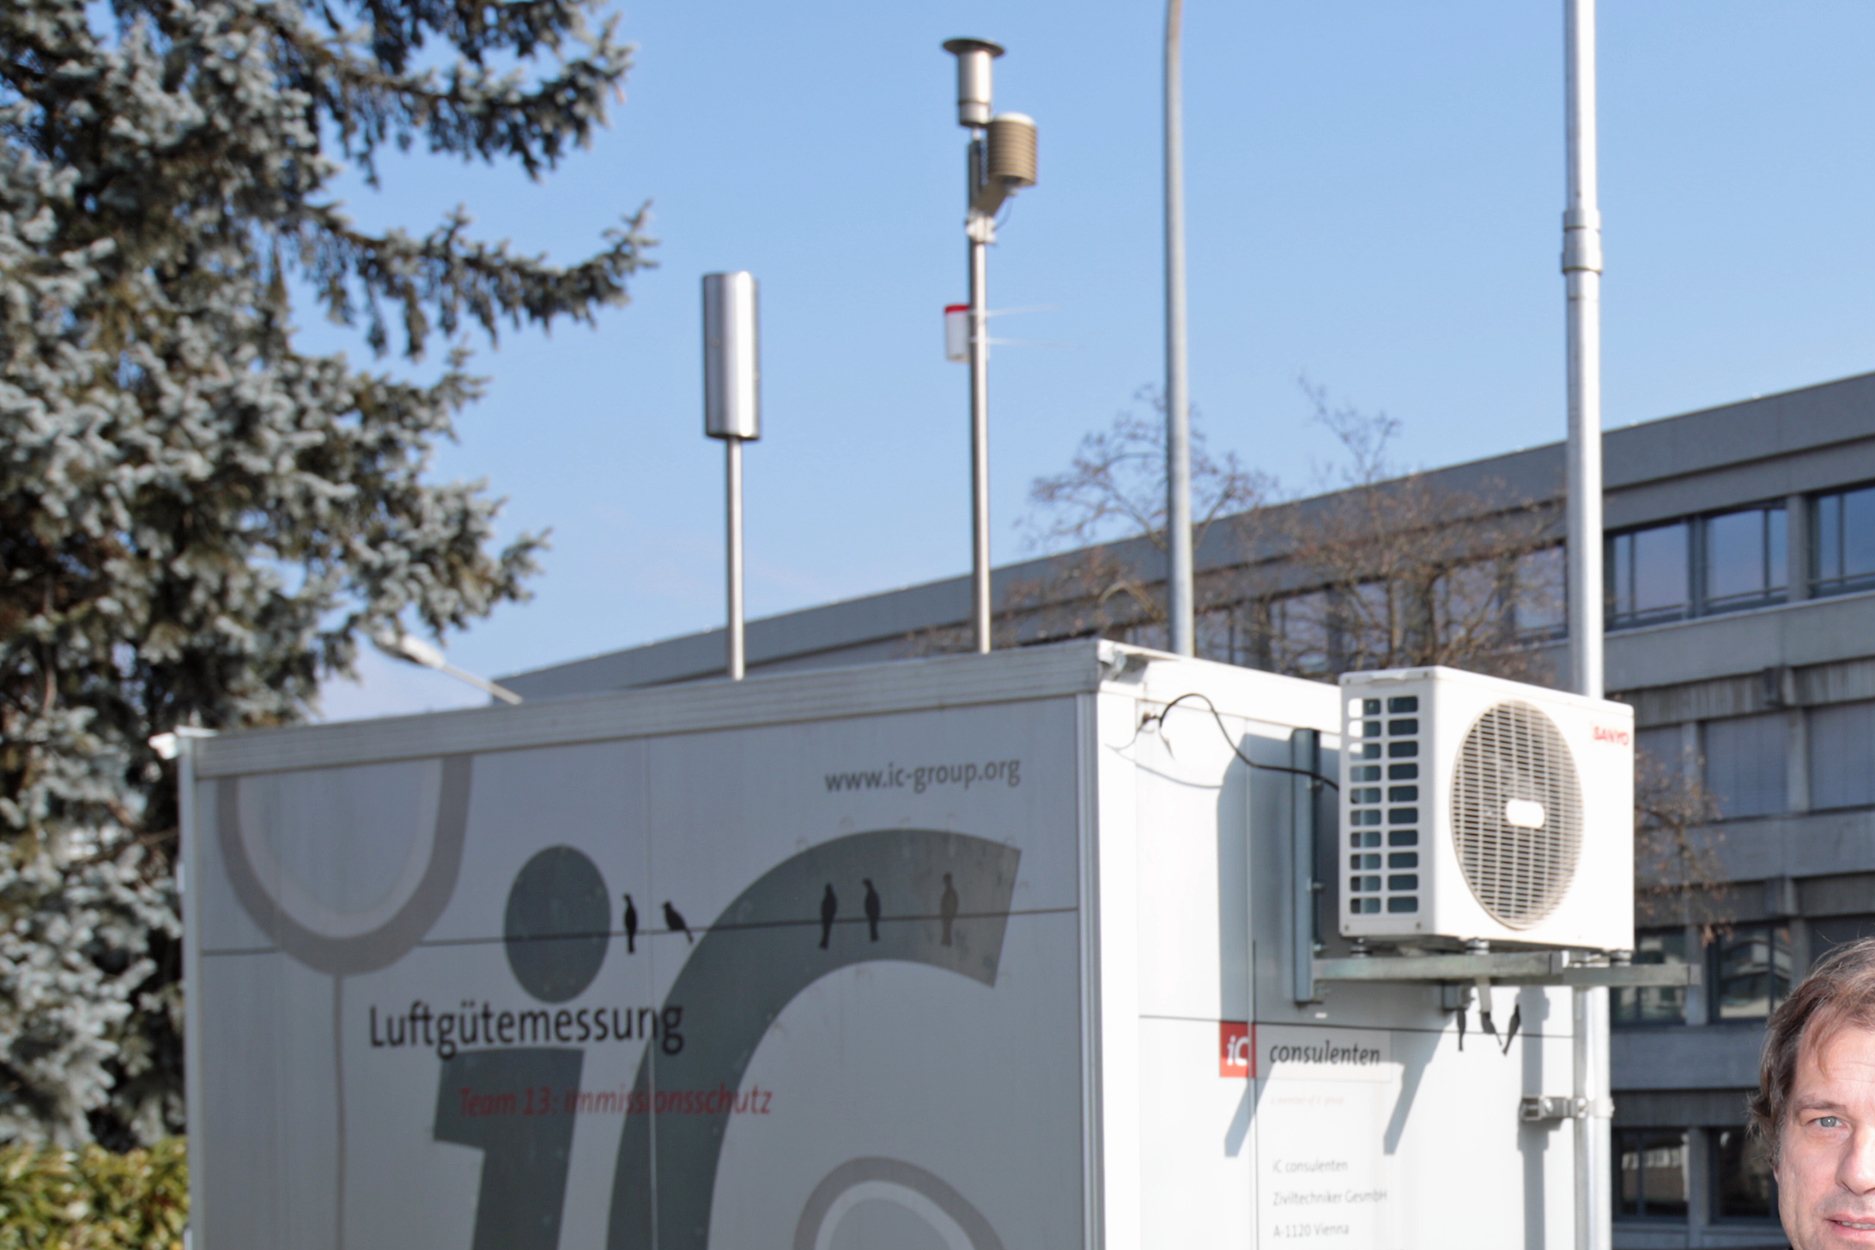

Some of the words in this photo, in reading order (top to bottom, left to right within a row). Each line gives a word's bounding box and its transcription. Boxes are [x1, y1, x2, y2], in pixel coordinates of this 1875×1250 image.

[824, 758, 1022, 795] www.ic-group.org
[369, 999, 684, 1060] Luftgütemessung
[1226, 1034, 1250, 1067] iC
[1269, 1038, 1381, 1066] consulenten
[459, 1086, 518, 1118] Team
[1285, 1157, 1349, 1173] consulenten
[1273, 1189, 1342, 1207] Ziviltechniker
[1314, 1221, 1350, 1236] Vienna
